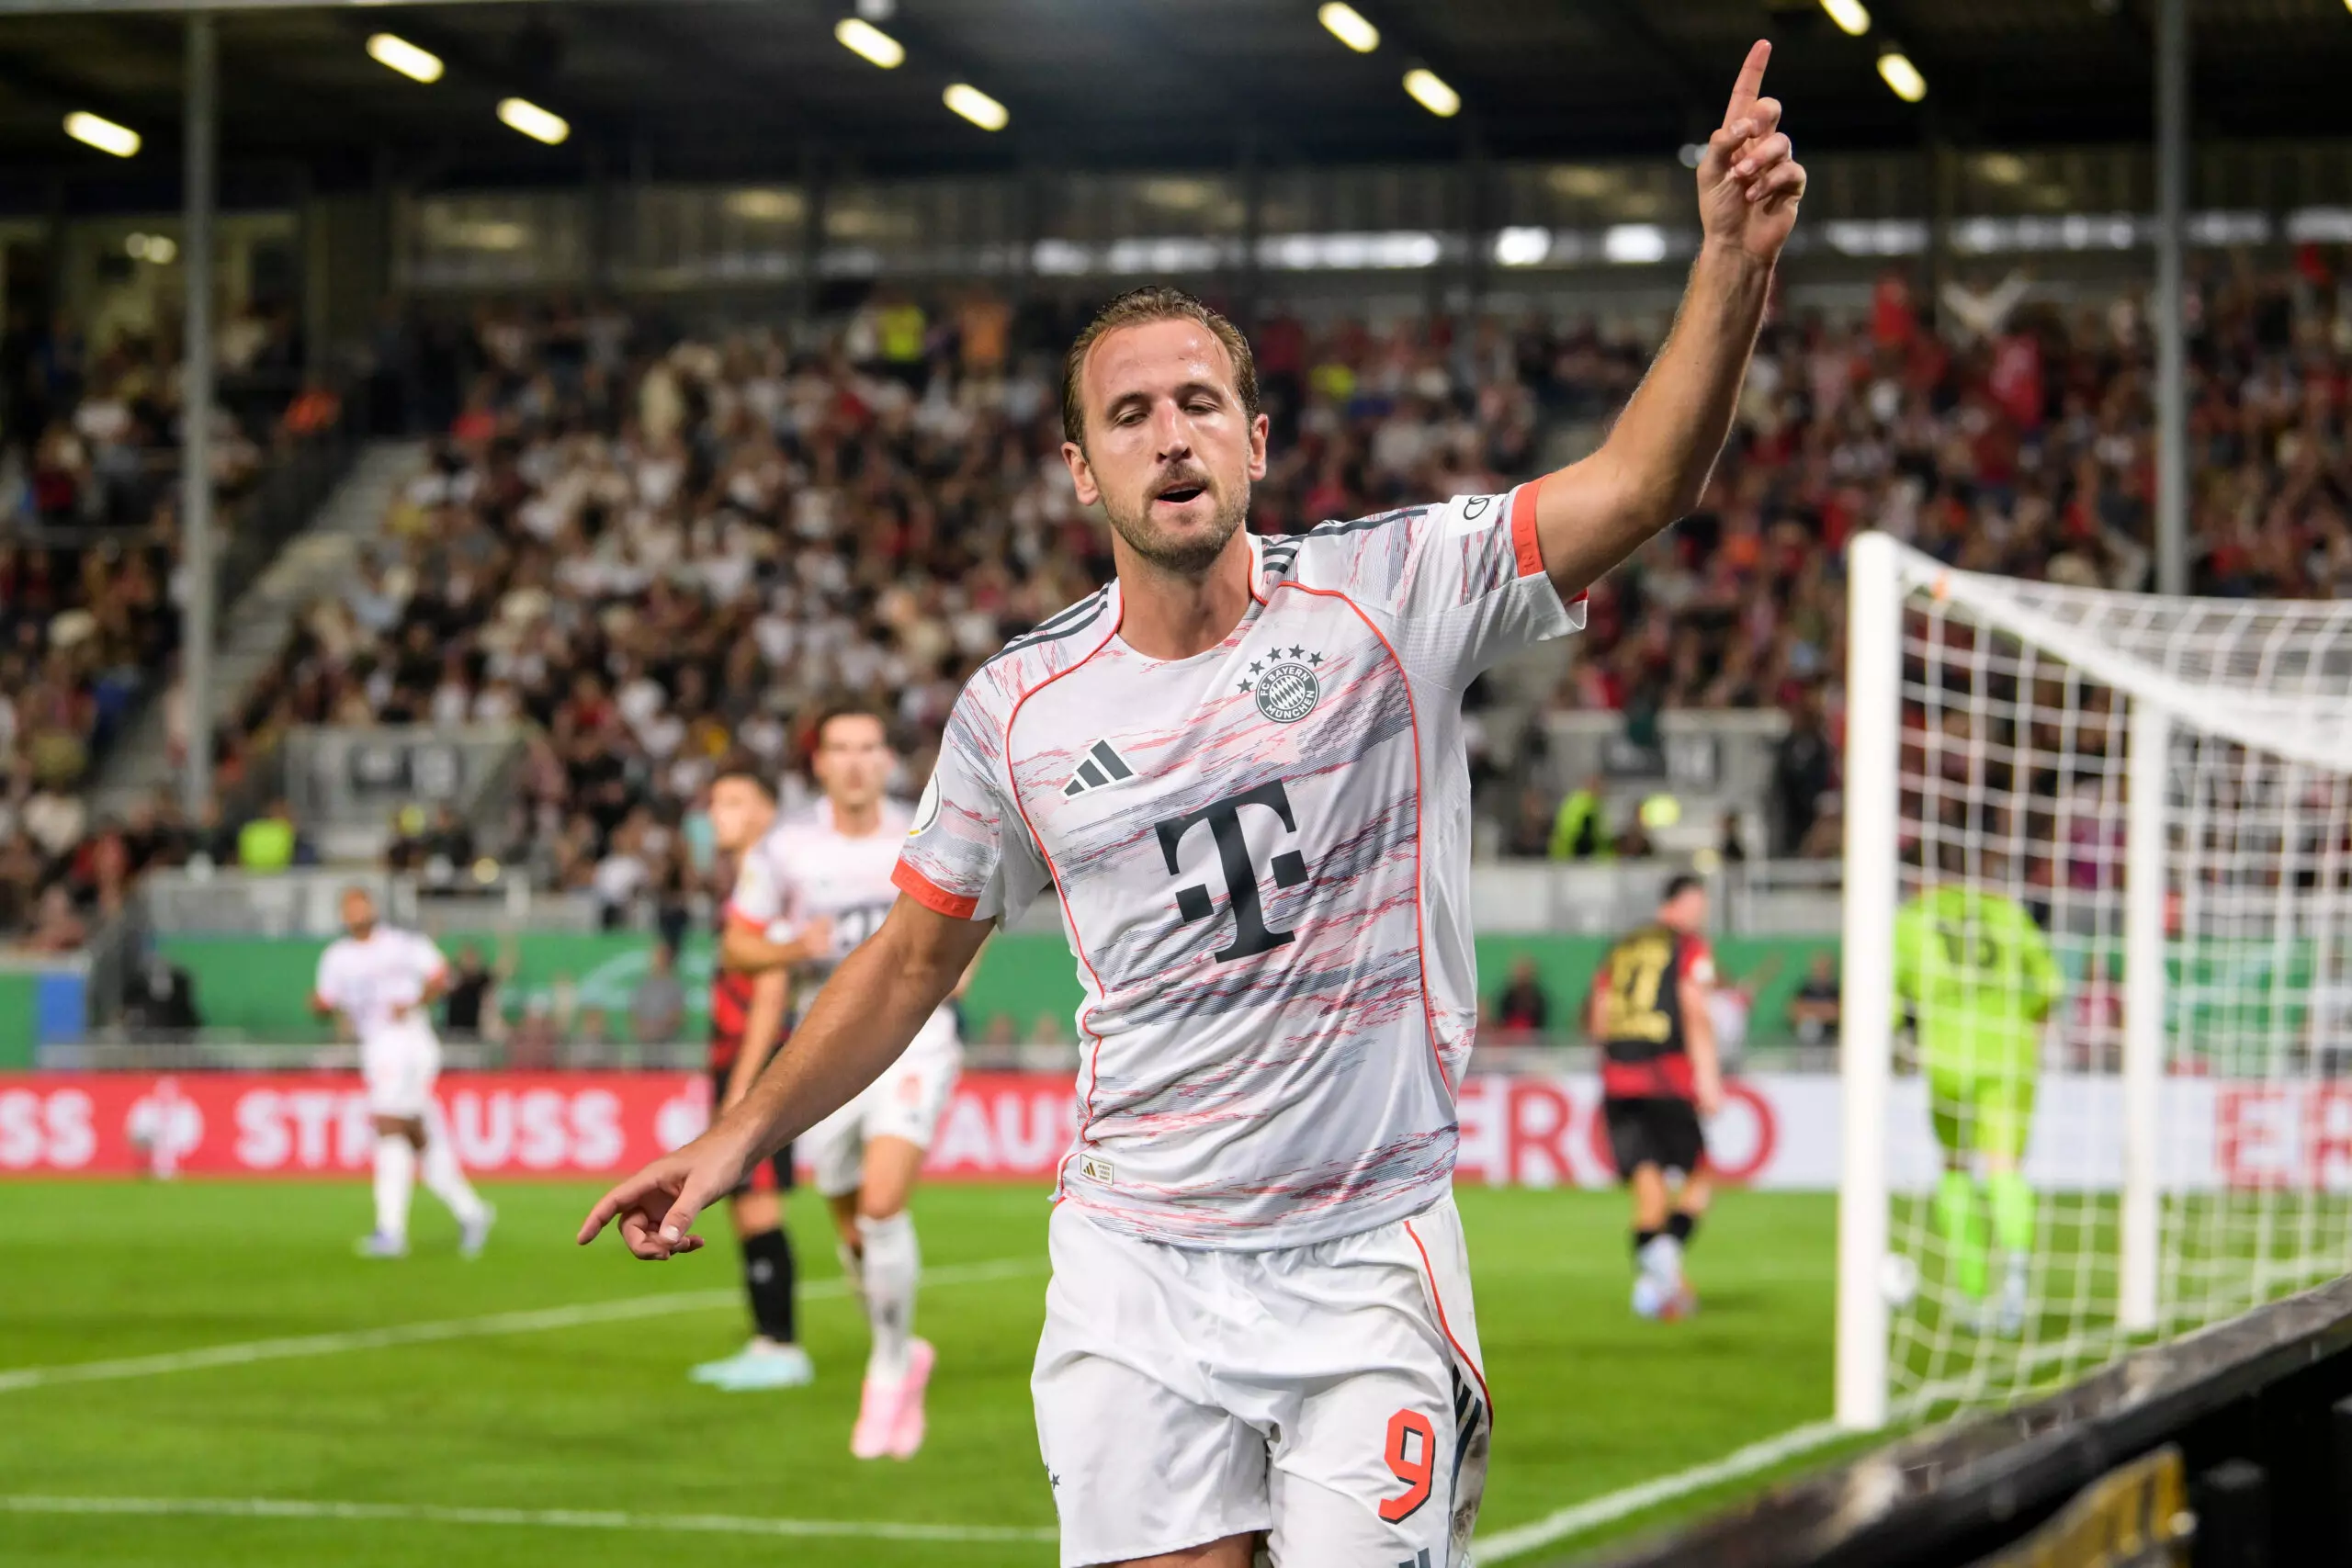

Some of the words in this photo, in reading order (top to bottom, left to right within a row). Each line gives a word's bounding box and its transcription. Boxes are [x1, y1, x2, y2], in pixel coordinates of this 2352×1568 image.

[1260, 682, 1270, 696] FC
[1268, 667, 1310, 682] BAYERN
[1265, 690, 1315, 719] MÜNCHEN
[1154, 778, 1309, 964] T
[1378, 1408, 1435, 1525] 9
